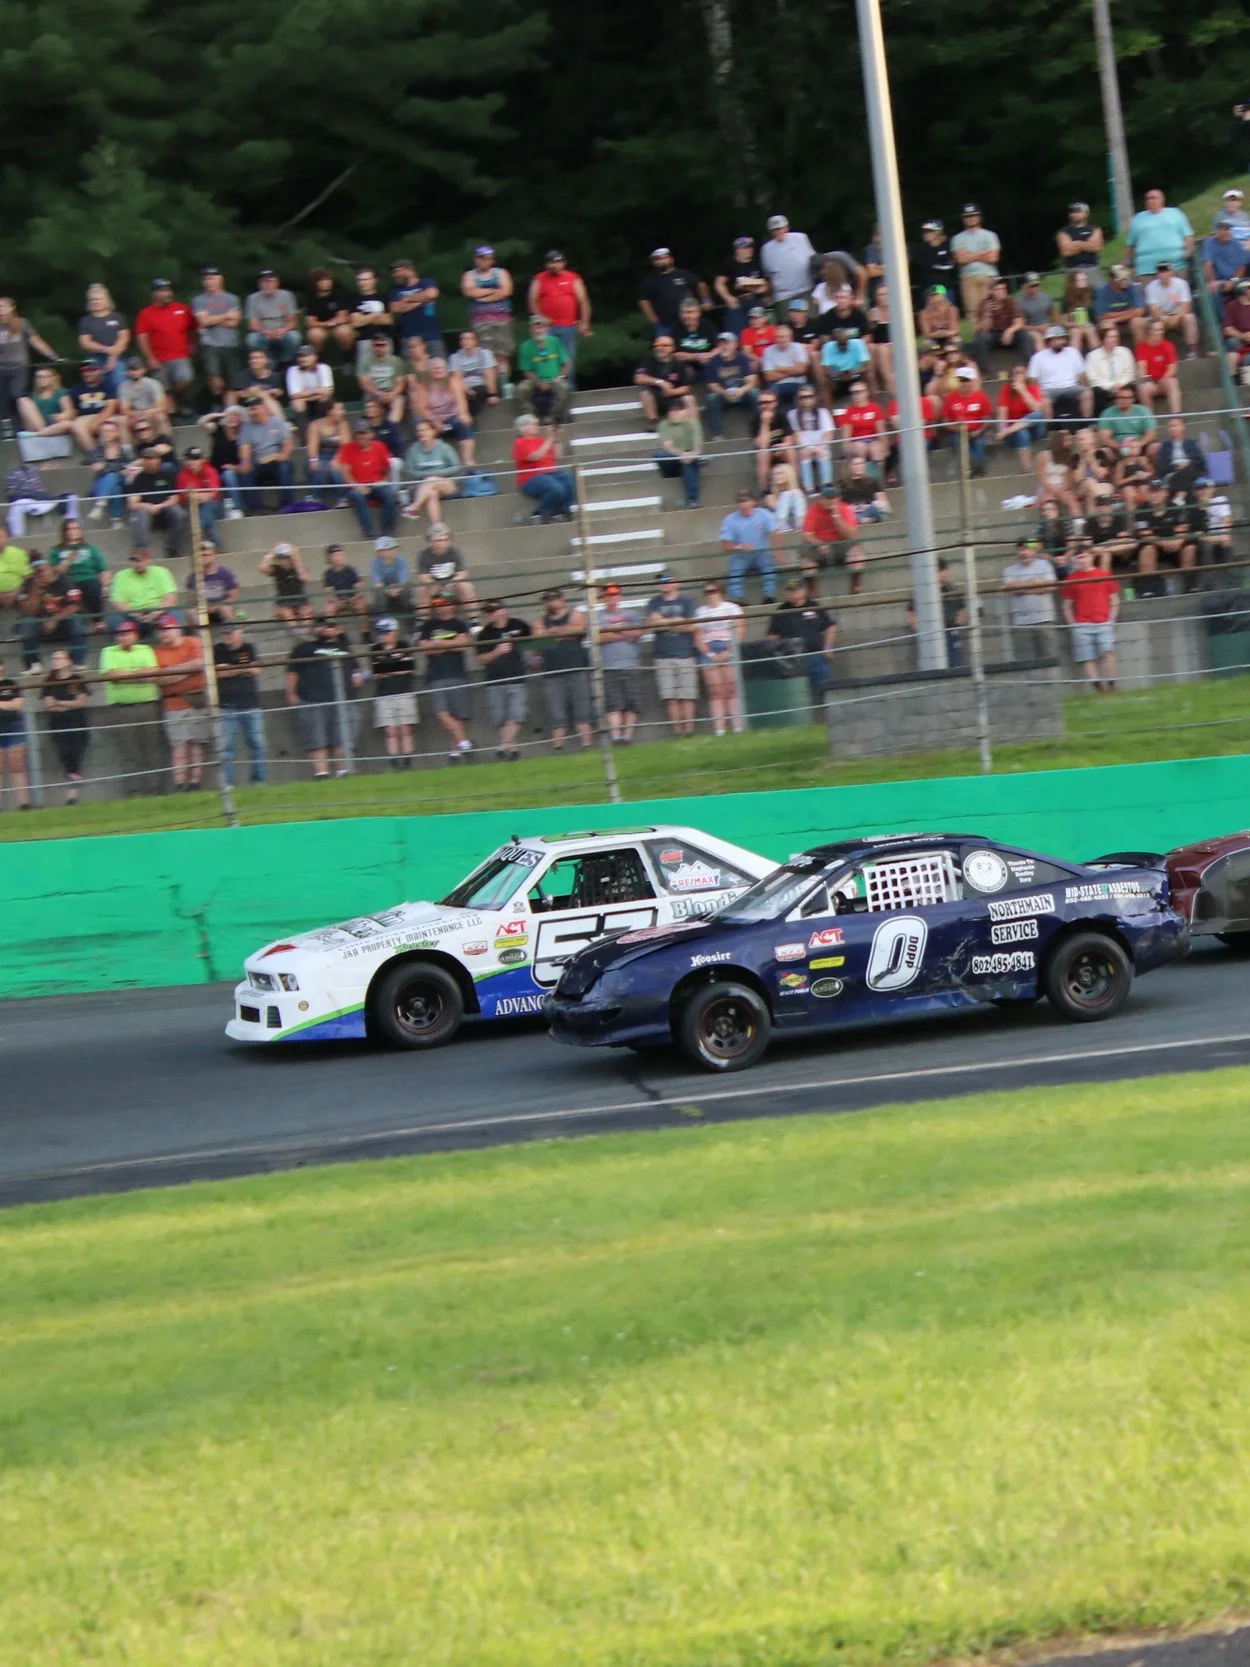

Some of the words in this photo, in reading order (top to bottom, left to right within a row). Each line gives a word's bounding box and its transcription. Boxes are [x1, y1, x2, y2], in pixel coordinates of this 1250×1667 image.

[678, 875, 714, 887] RE/MAX
[1065, 883, 1102, 898] MID-STATE
[989, 895, 1052, 919] NORTHMAIN
[362, 937, 400, 954] PROPERTY
[406, 921, 464, 943] MAINTENANCE
[468, 917, 482, 928] LLC
[496, 920, 527, 936] ACT
[808, 928, 843, 947] ACT
[993, 922, 1037, 942] SERVICE
[690, 951, 731, 967] Hoosier
[866, 915, 928, 991] 0
[905, 935, 919, 968] DOPP
